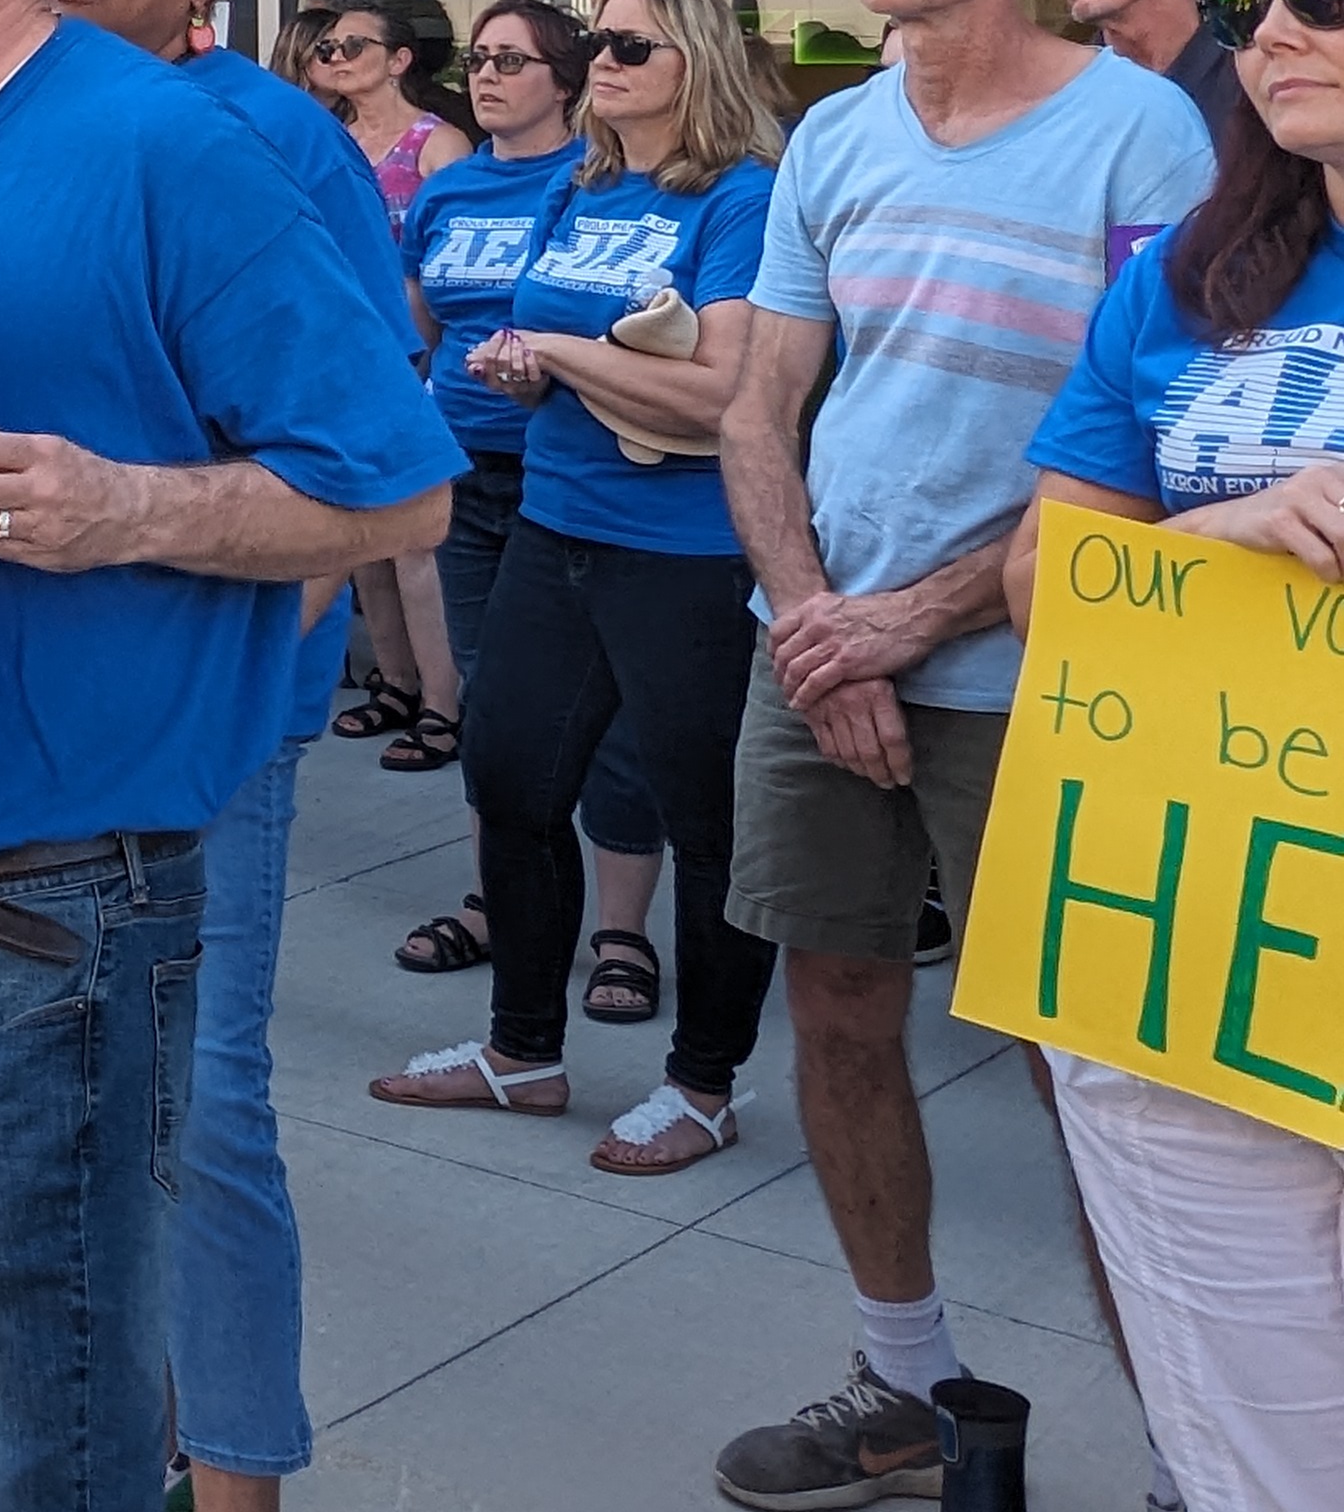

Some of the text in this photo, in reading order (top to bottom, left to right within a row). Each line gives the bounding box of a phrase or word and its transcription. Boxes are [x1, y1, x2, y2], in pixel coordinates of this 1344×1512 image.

[1070, 533, 1207, 618] our
[1041, 660, 1329, 797] to be
[1038, 779, 1344, 1104] HE
